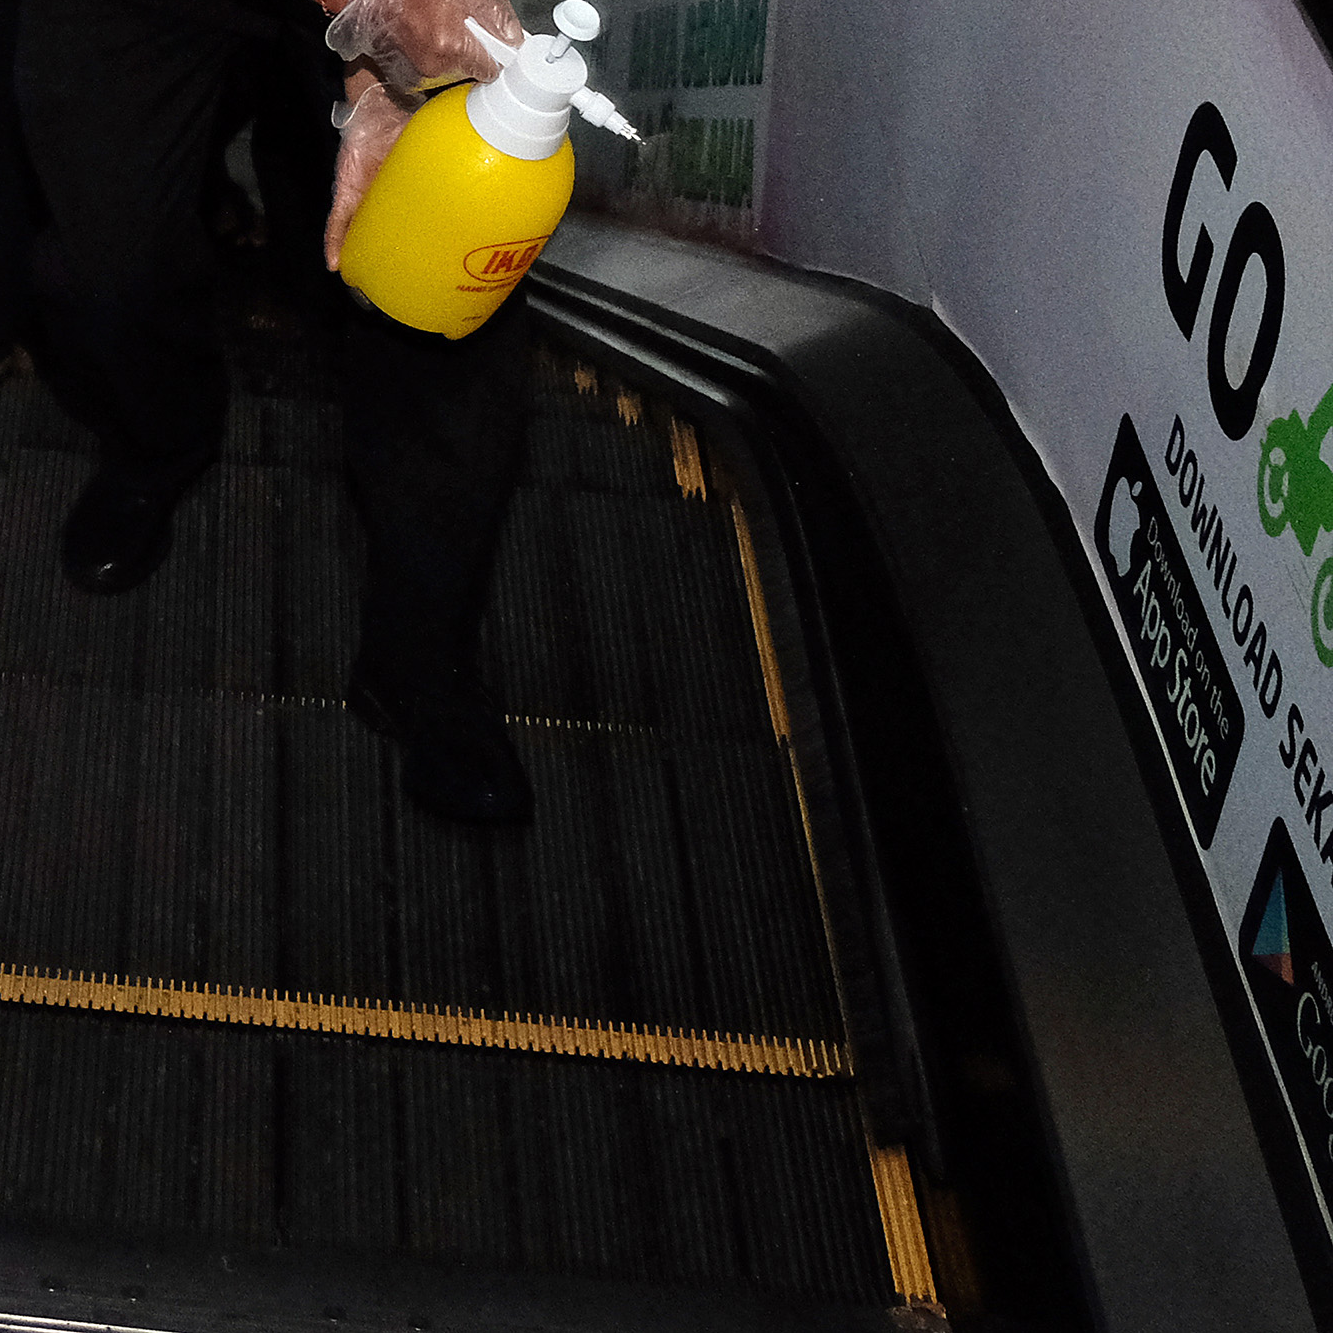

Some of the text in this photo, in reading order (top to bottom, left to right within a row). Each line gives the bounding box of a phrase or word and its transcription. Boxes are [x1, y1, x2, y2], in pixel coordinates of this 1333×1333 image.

[1162, 100, 1286, 441] GO
[1133, 559, 1217, 797] App Store
[1146, 515, 1230, 740] Download on the
[1164, 413, 1333, 888] DOWNLOAD SEK
